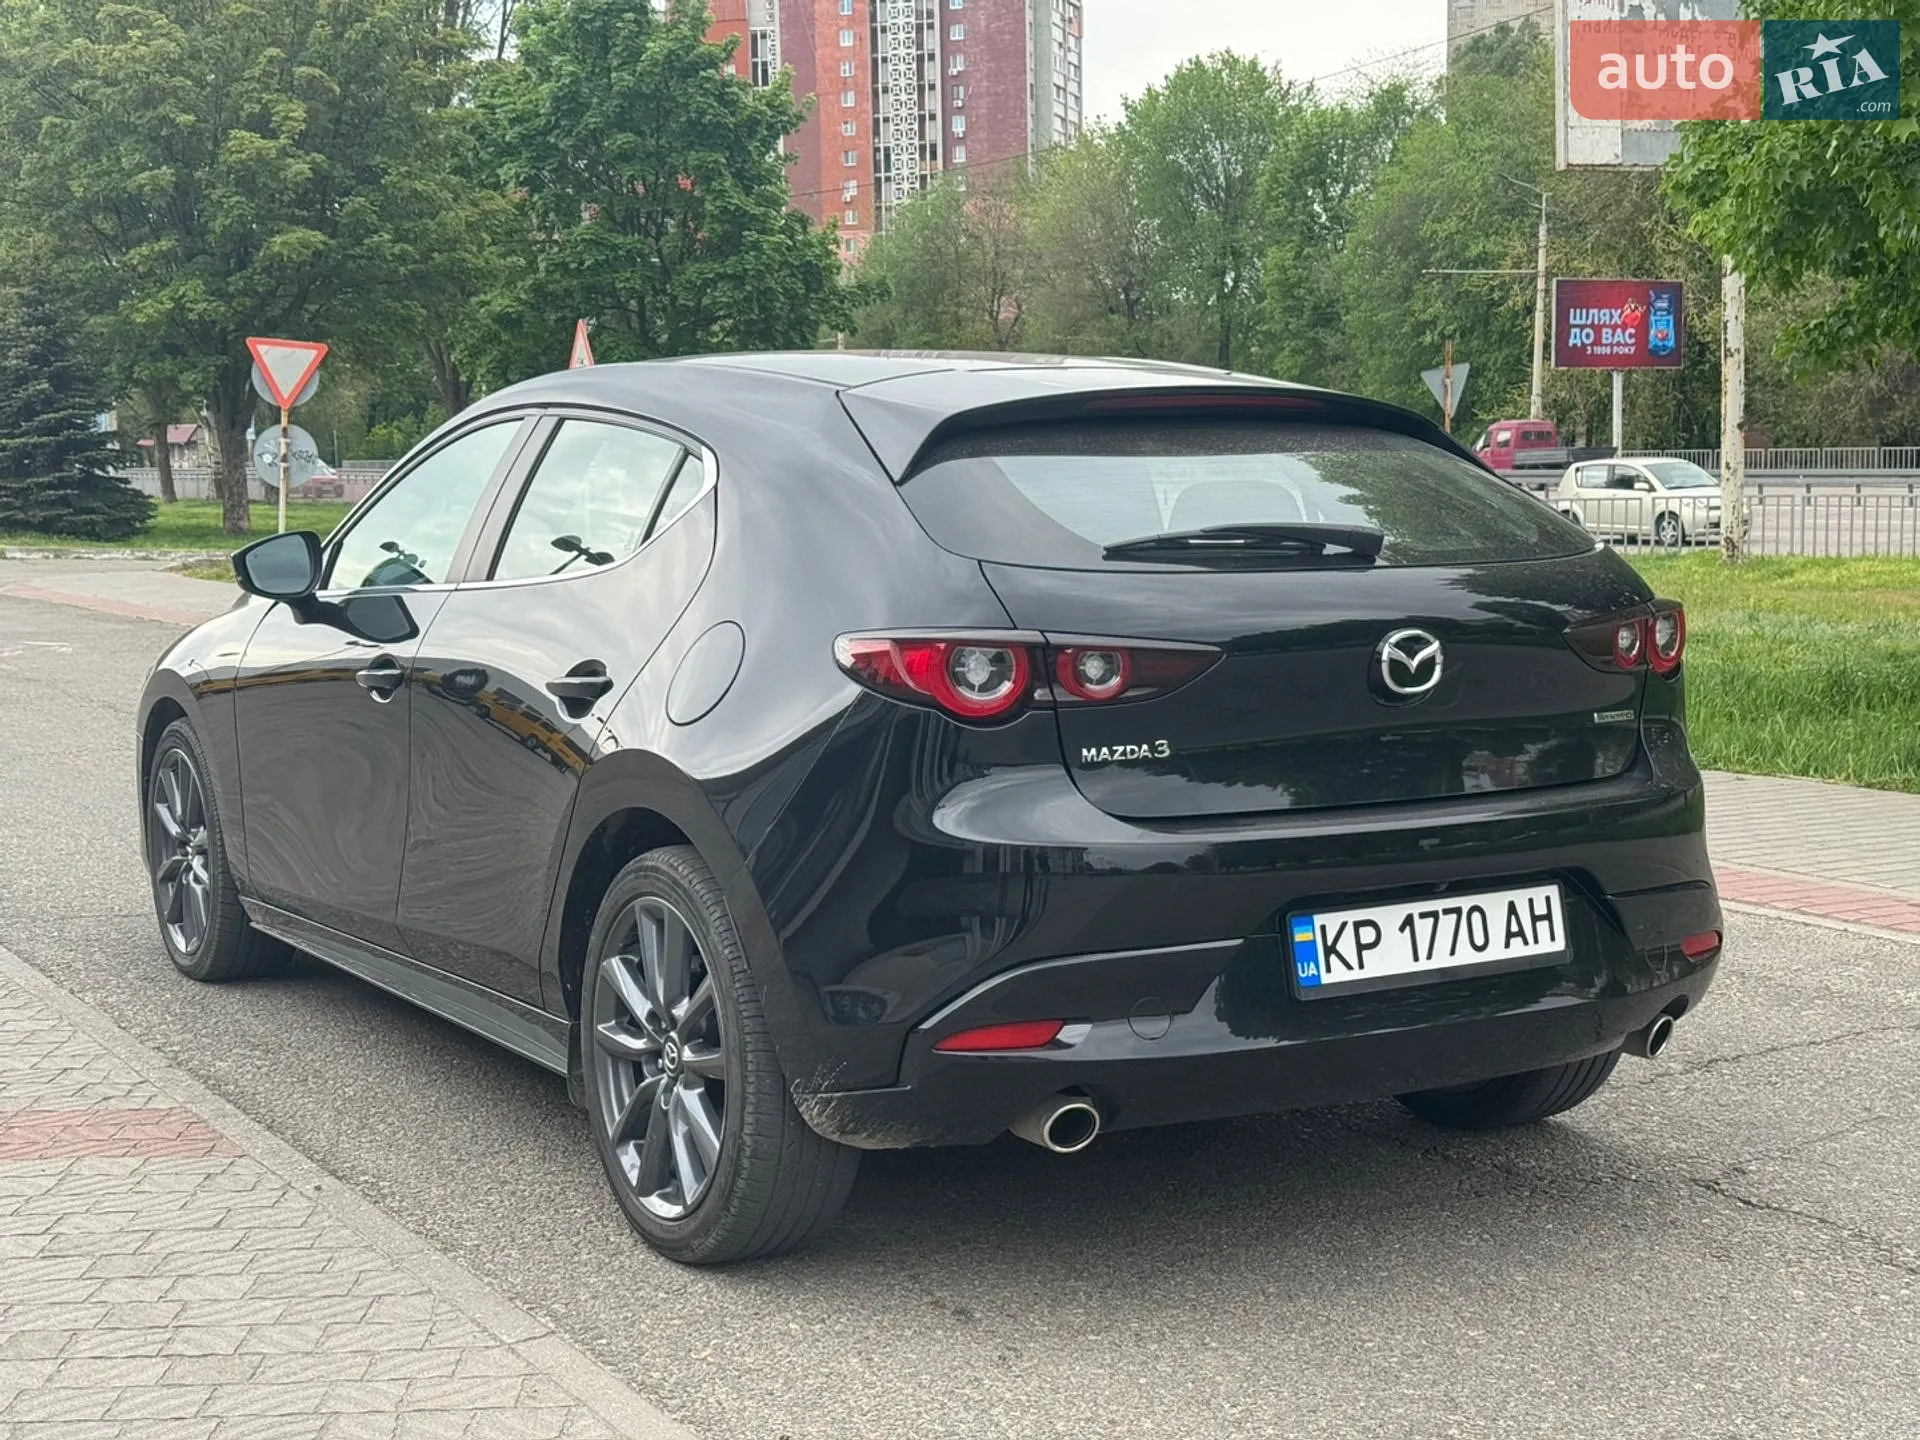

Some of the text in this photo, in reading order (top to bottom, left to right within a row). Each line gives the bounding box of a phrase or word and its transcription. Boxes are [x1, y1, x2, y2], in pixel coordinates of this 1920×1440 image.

[1569, 308, 1622, 325] ШЛЯХ
[1568, 327, 1636, 347] ДО ВАС
[1612, 346, 1636, 355] РОКУ
[1319, 894, 1556, 974] KP 1770 AH
[1297, 962, 1318, 978] UA
